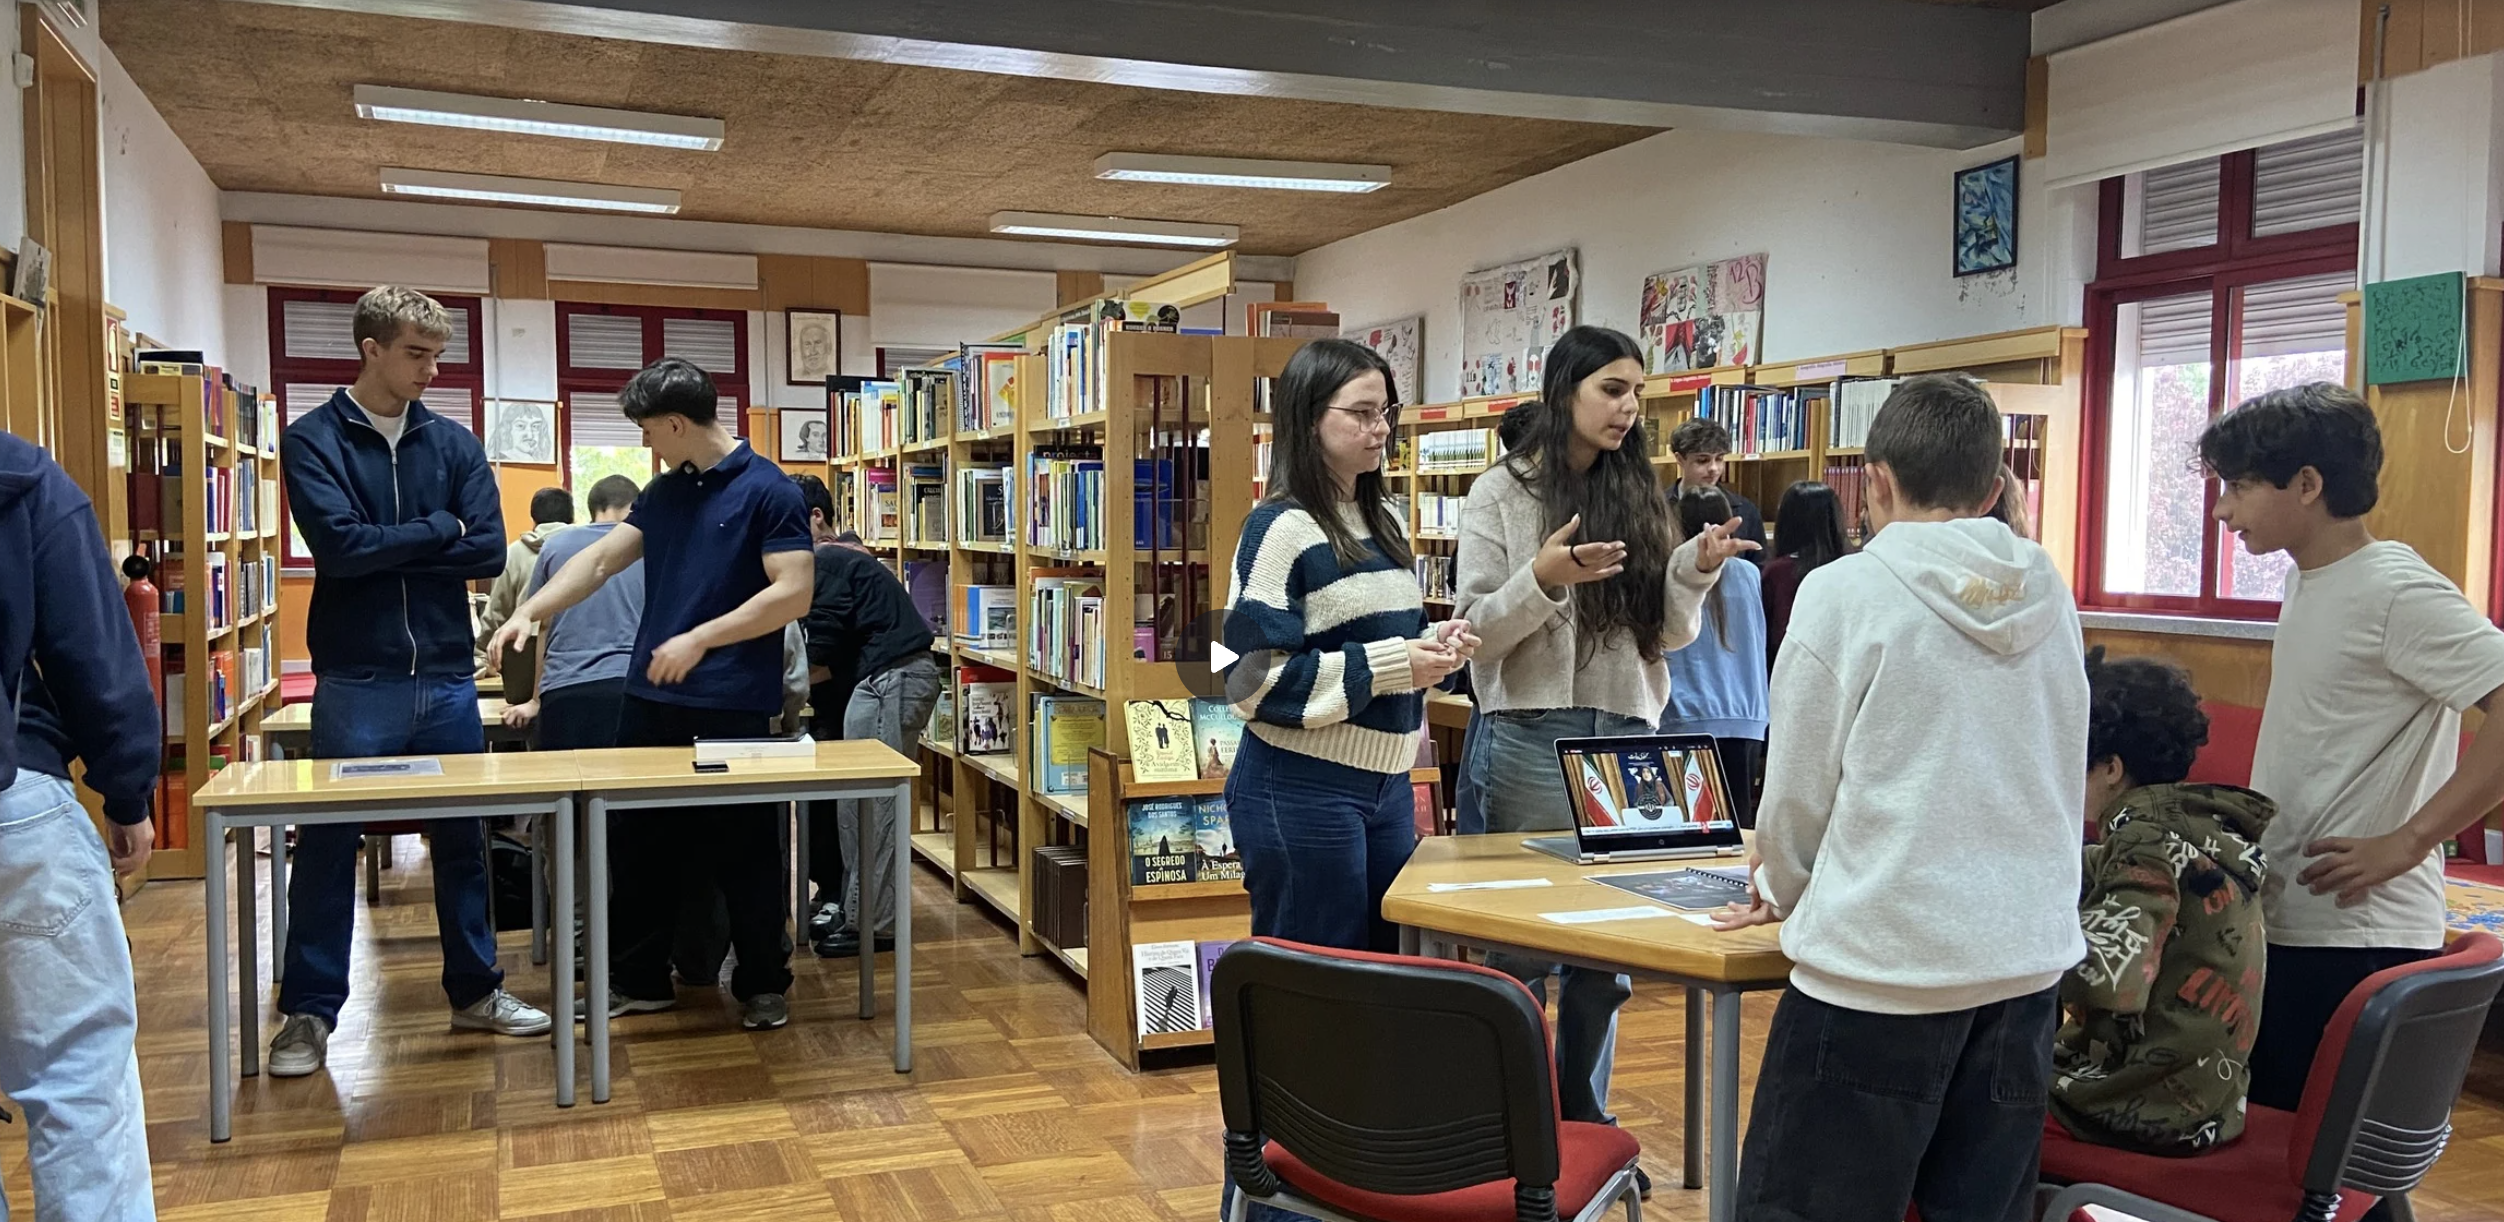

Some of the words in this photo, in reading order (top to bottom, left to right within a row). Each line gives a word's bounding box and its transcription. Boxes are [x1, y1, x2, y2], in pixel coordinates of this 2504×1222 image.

[1163, 651, 1172, 659] 15
[1155, 802, 1183, 811] RODRIGUES
[1148, 811, 1158, 819] DOS
[1158, 810, 1177, 818] SANTOS
[1145, 857, 1151, 867] O
[1152, 855, 1186, 867] SEGREDO
[1146, 869, 1187, 883] ESPINOSA
[1201, 871, 1219, 880] Um
